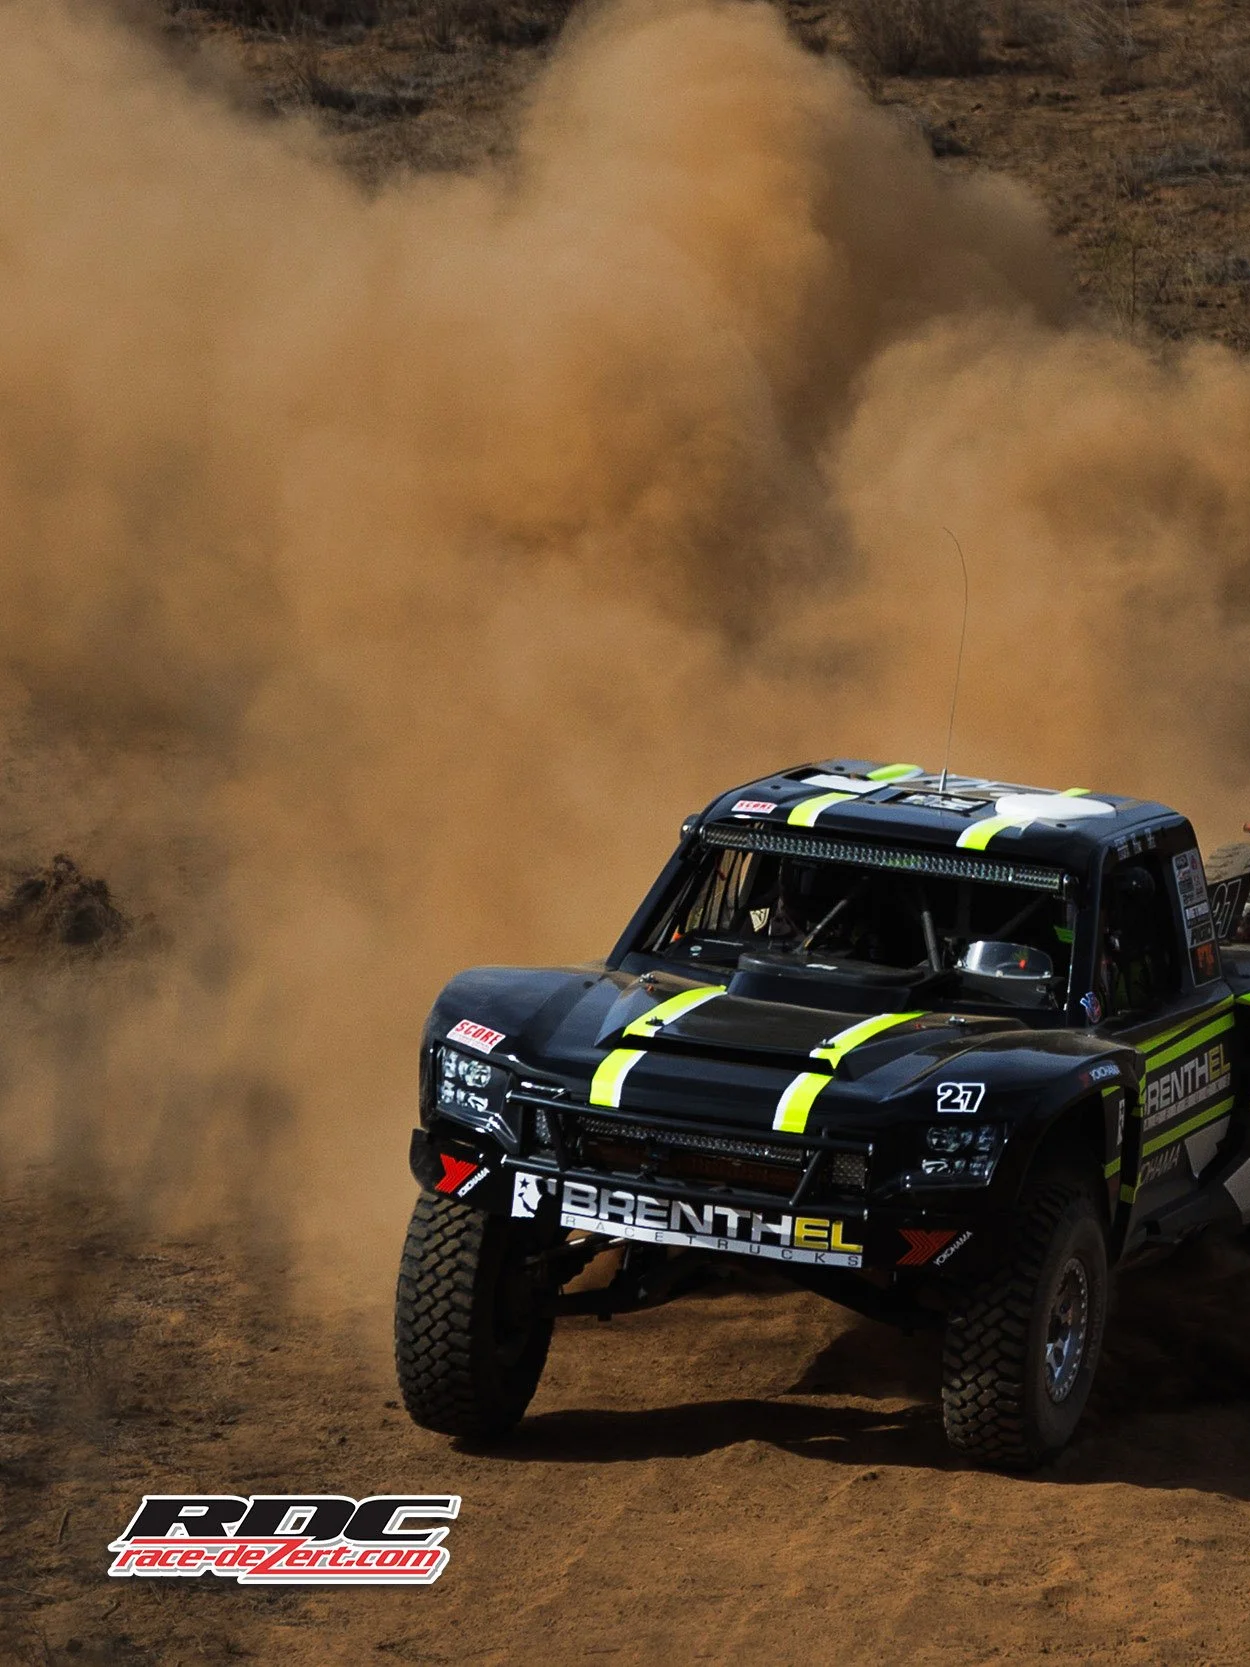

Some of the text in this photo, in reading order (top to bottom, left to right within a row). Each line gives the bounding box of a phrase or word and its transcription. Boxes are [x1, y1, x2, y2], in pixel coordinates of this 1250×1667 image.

[455, 1021, 502, 1046] SCORE
[937, 1082, 986, 1114] 27
[1141, 1043, 1231, 1116] RENTHEL
[561, 1181, 864, 1254] BRENTHEL
[932, 1230, 973, 1267] YOKOHAMA
